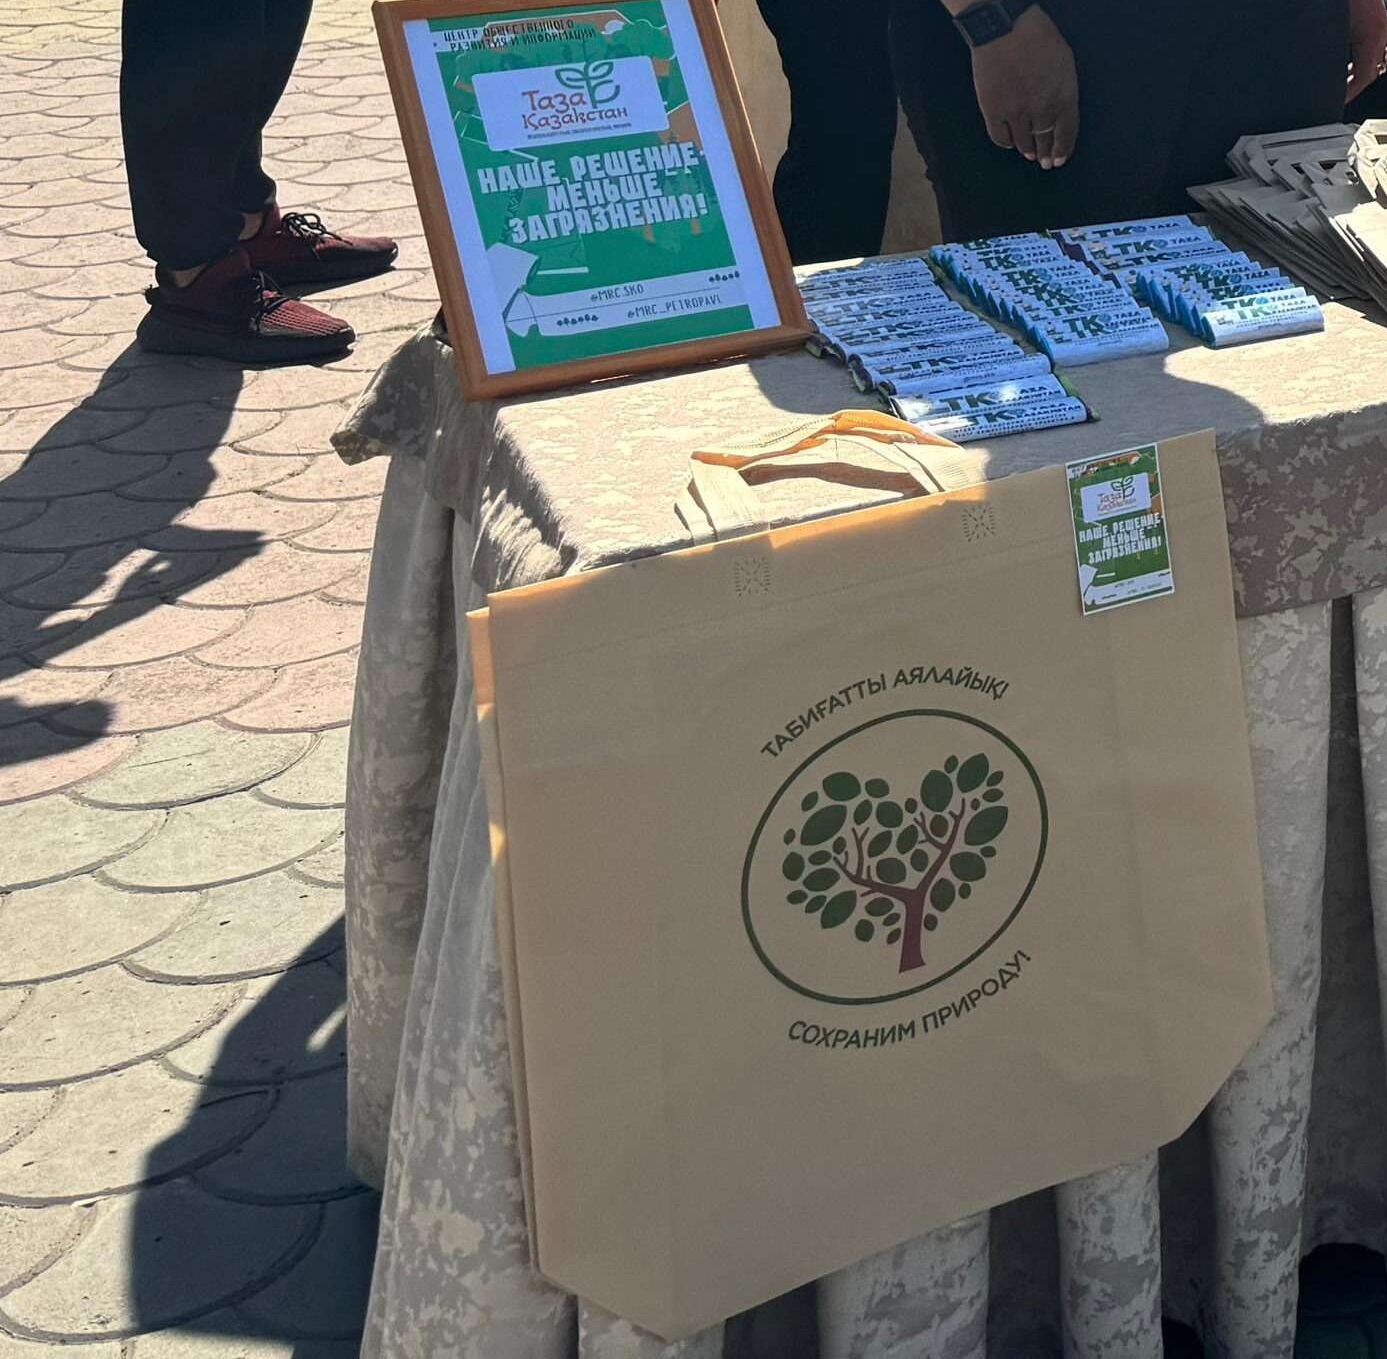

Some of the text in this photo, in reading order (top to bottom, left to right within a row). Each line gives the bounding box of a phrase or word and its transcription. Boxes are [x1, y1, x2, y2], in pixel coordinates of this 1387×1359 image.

[443, 28, 478, 42] ЦЕНТР
[521, 89, 587, 114] Таза
[521, 106, 629, 131] Қазақстан
[477, 142, 700, 194] НАШЕ РЕШЕНИЕ
[547, 173, 663, 211] МЕНЬШЕ
[508, 192, 709, 244] ЗАГРЯЗНЕНИЯ!
[590, 284, 645, 303] @MRC.SKO
[627, 294, 723, 319] @MRC_PETROPAVL
[940, 391, 1001, 412] TK
[1079, 513, 1161, 543] НАШЕ РЕШЕНИЕ
[1103, 527, 1145, 549] МЕНЬШЕ
[1088, 536, 1162, 565] ЗАГРЯЗНЕНИЯ!
[760, 665, 1010, 759] ТАБИҒАТТЫ АЯЛАЙЫҚ!
[788, 949, 1032, 1049] СОХРАНИМ ПРИРОДУ!
